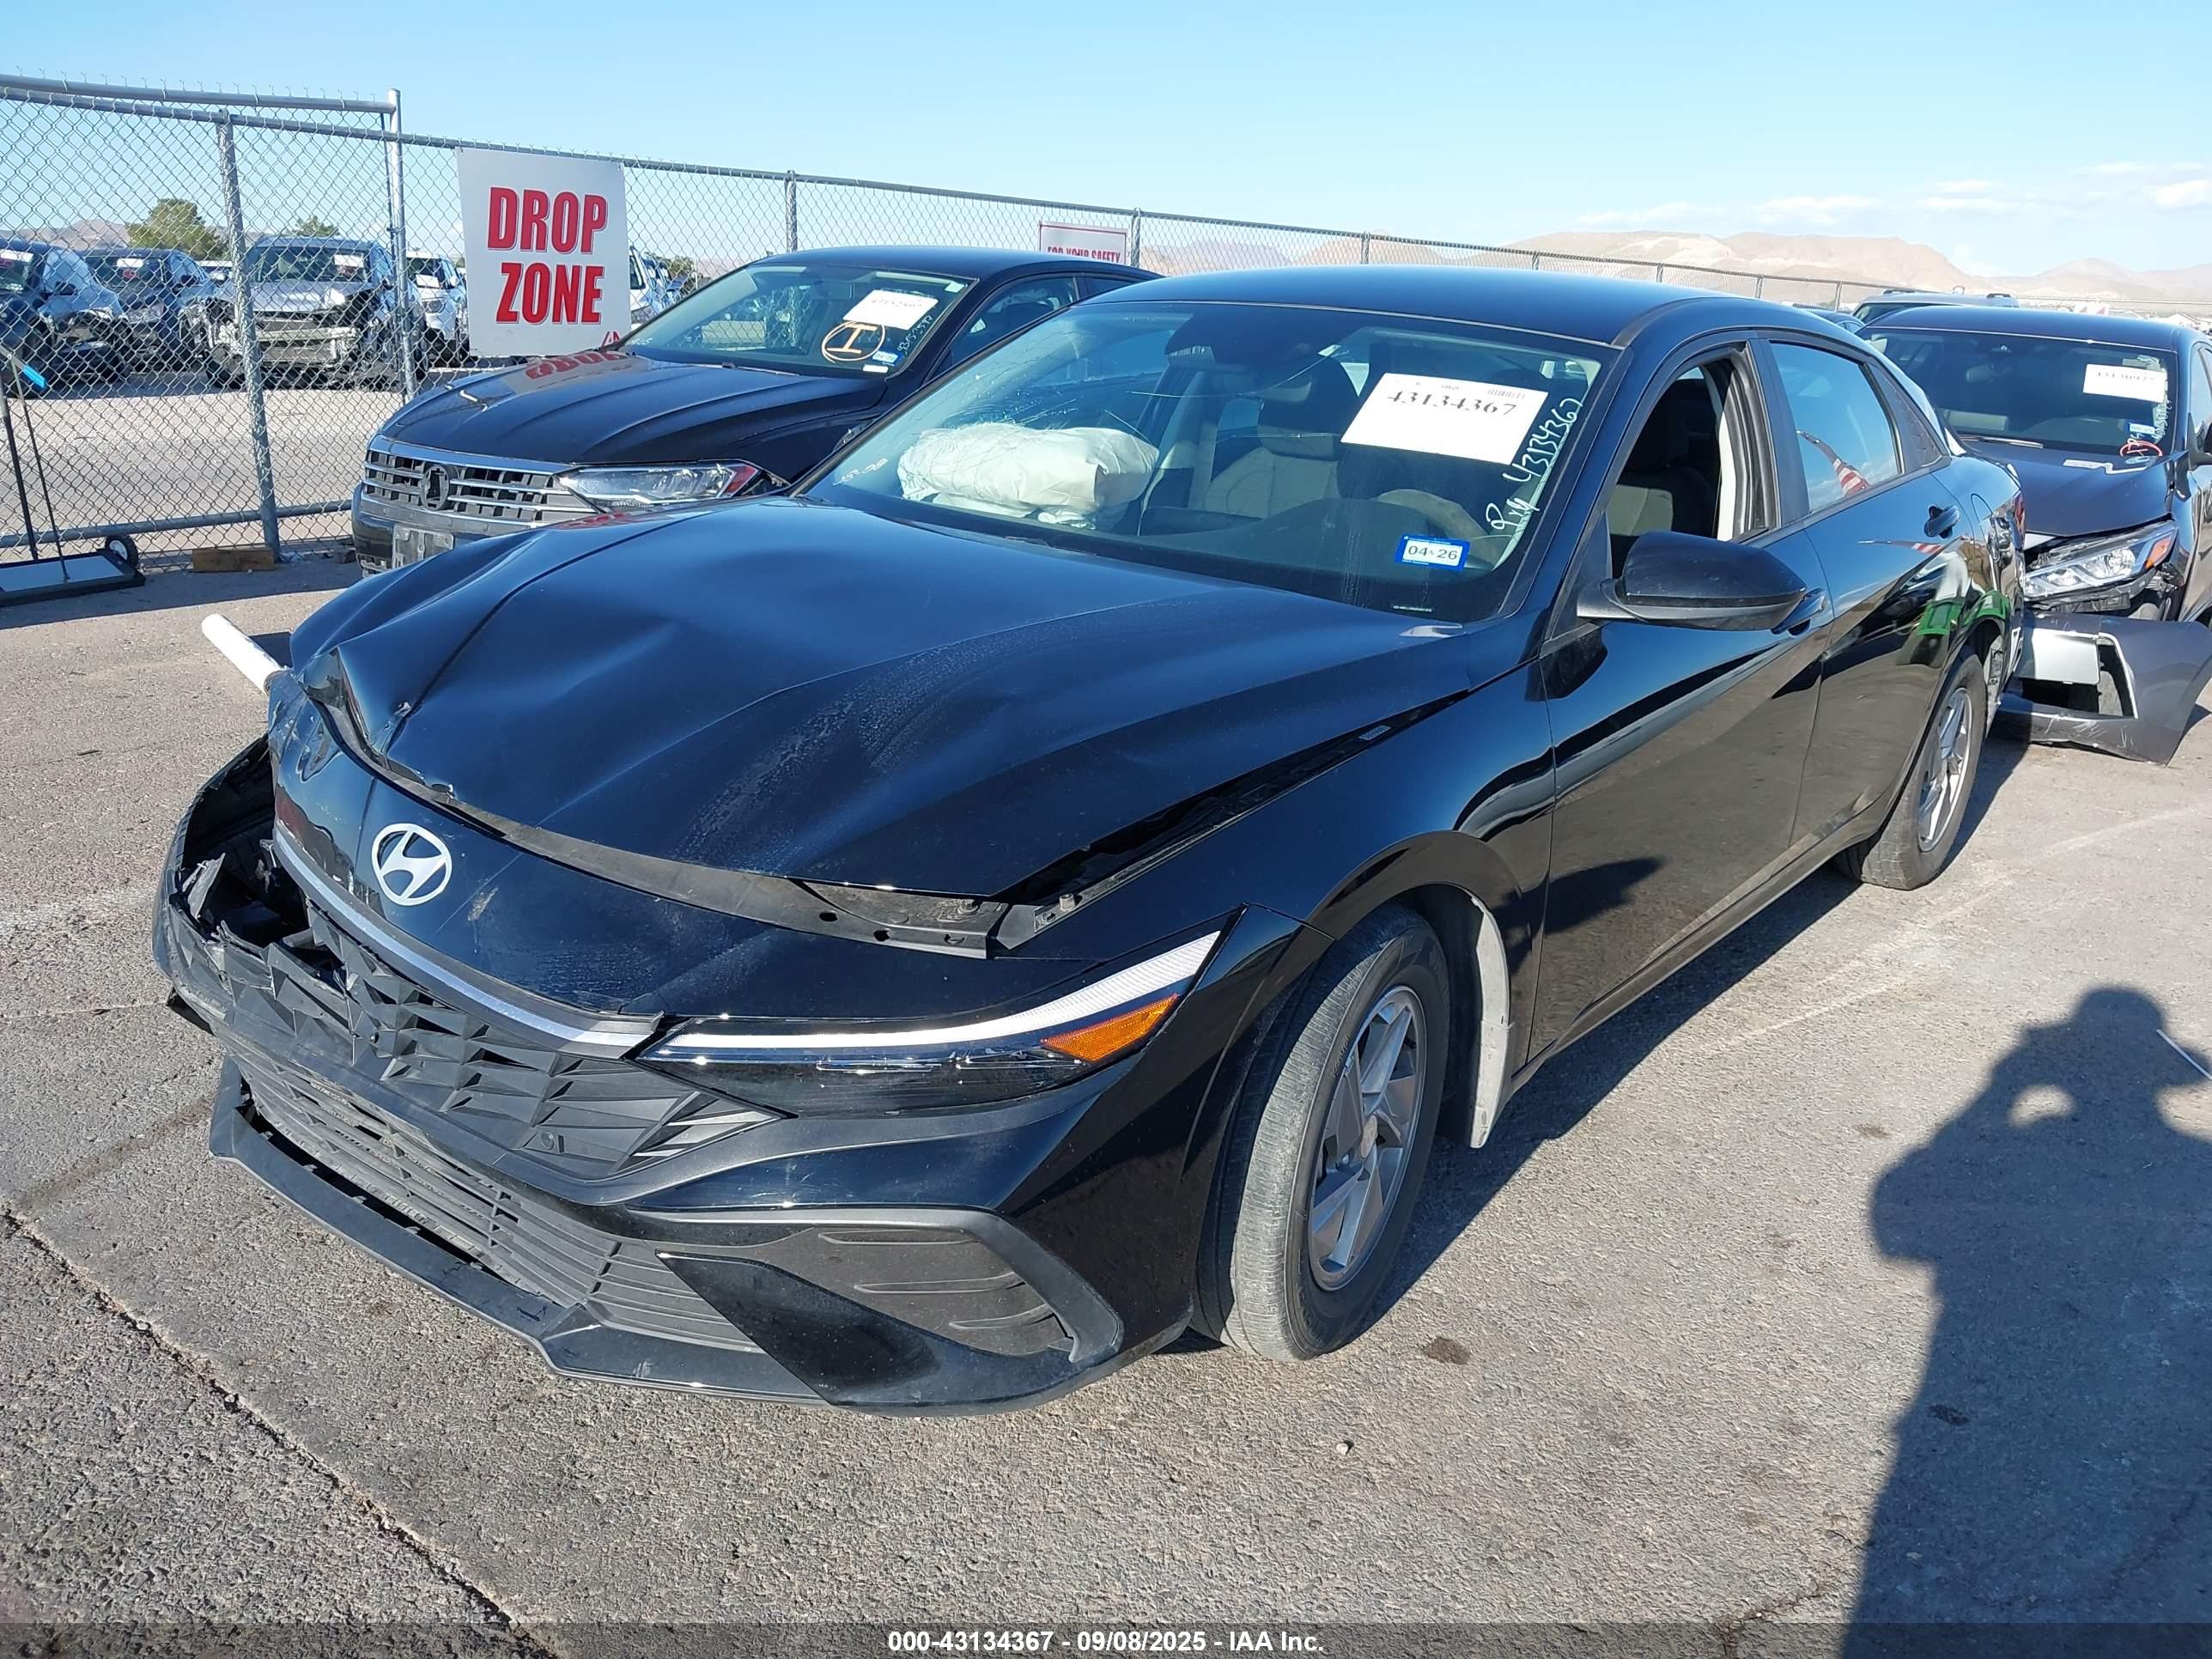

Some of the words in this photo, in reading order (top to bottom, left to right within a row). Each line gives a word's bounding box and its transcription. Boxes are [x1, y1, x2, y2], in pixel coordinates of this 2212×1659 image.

[488, 185, 608, 254] DROP
[495, 261, 605, 325] ZONE
[1387, 391, 1517, 416] 43134367
[1408, 545, 1428, 556] 04
[1437, 549, 1457, 560] 26
